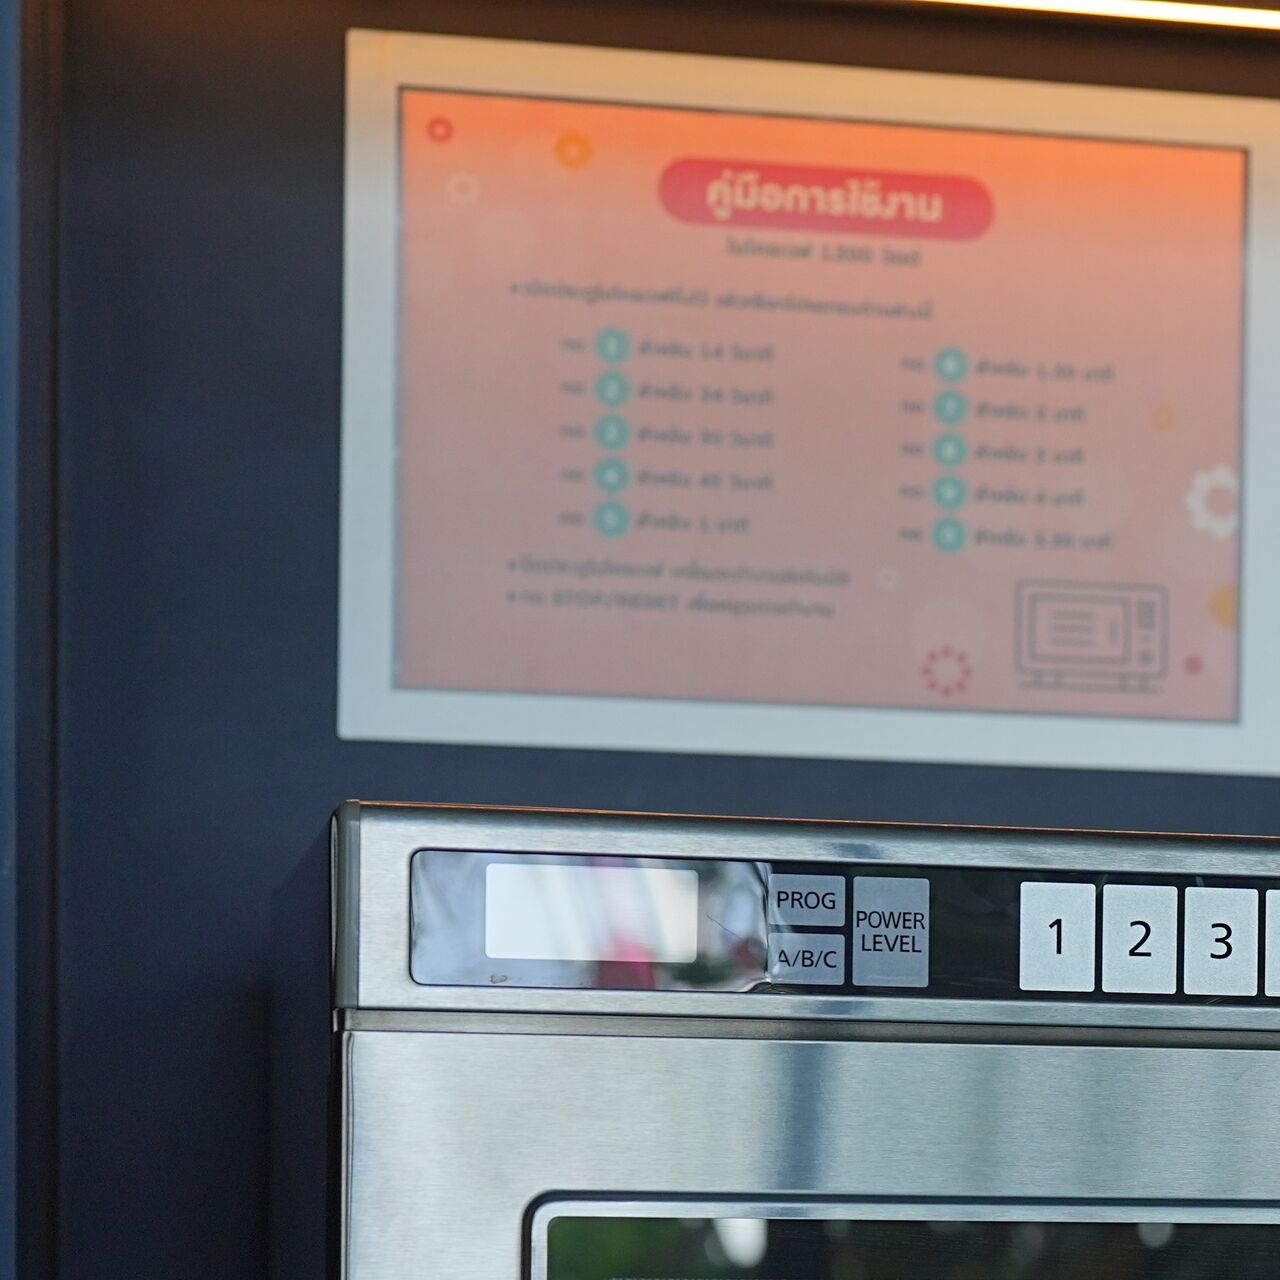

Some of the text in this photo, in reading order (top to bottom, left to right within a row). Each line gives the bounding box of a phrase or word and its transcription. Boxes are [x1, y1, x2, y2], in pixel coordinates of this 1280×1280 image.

[706, 169, 944, 224] คู่มือการใช้งาน
[777, 890, 836, 910] PROG
[856, 910, 926, 930] POWER
[861, 933, 922, 953] LEVEL
[1048, 918, 1062, 955] 1
[1128, 920, 1152, 957] 2
[1210, 922, 1233, 960] 3
[778, 949, 837, 969] A/B/C
